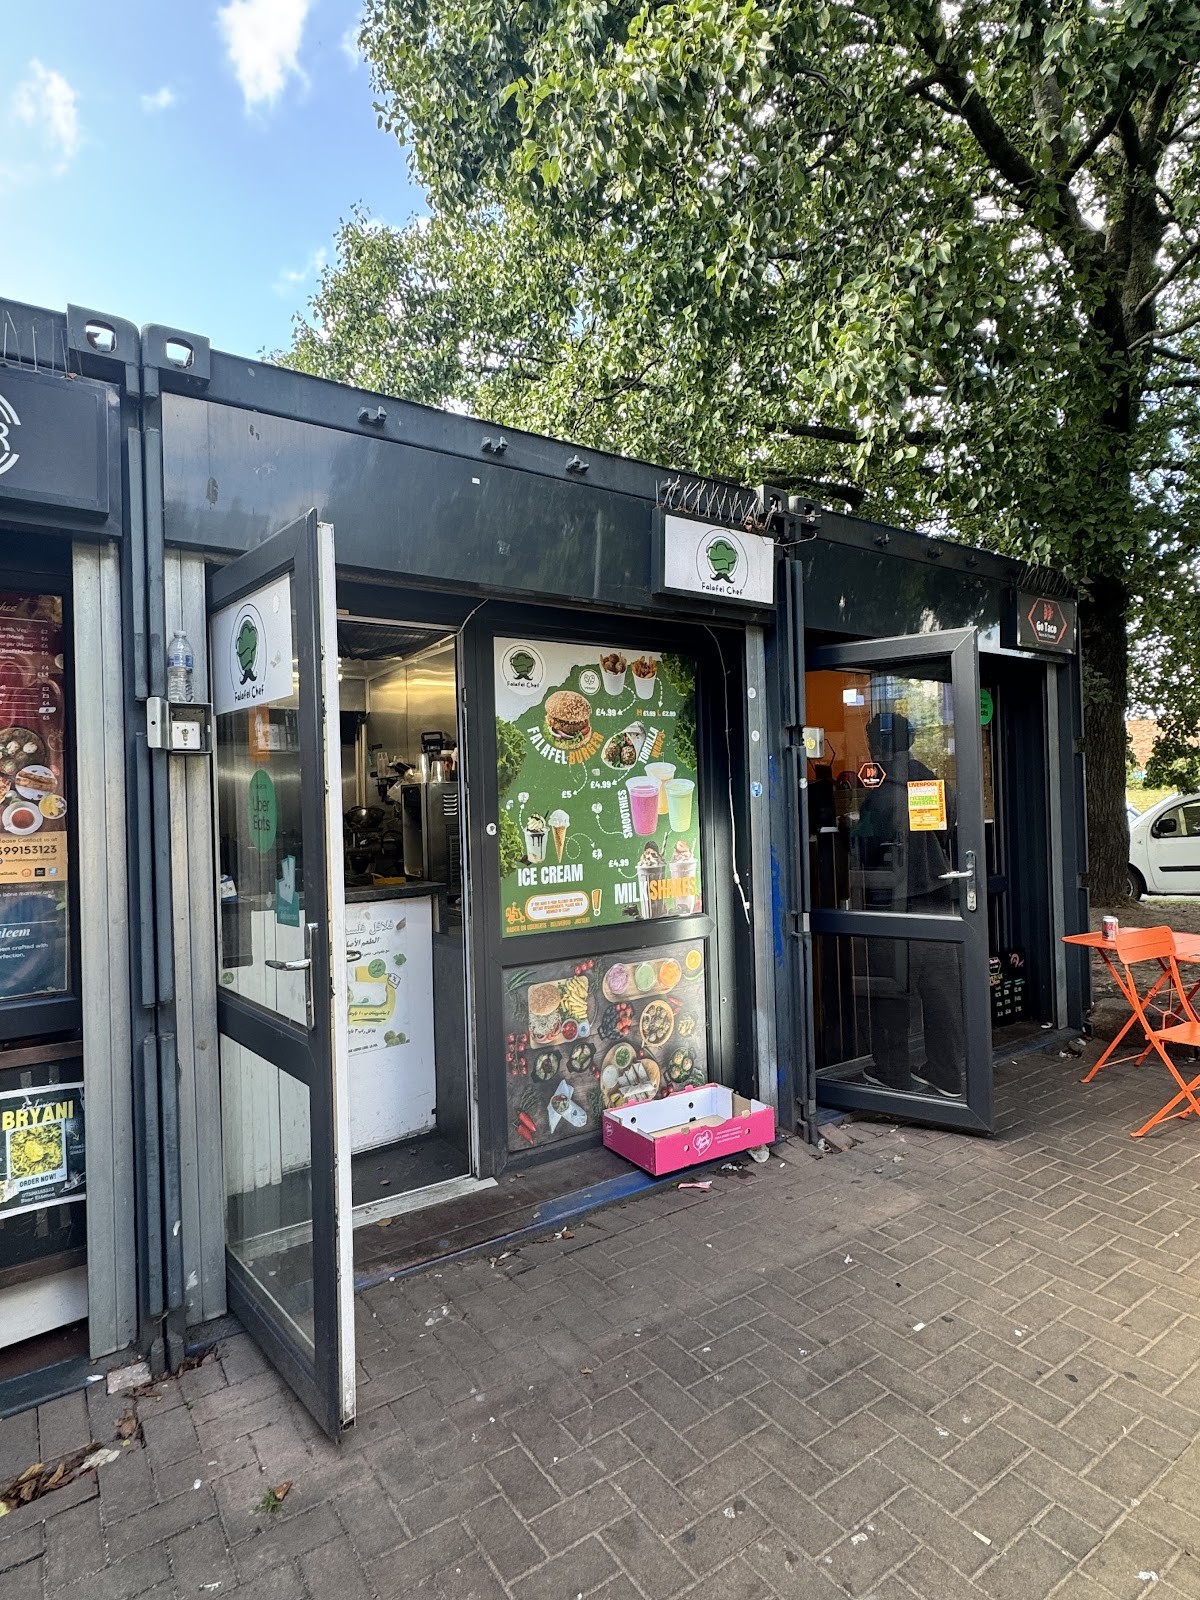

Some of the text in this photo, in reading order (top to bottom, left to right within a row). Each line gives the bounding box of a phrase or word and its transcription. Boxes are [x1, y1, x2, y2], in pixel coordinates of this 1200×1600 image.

[701, 581, 743, 595] Falafel Chef
[1036, 620, 1058, 634] Go Taco
[234, 684, 265, 703] Falafel Chef
[595, 707, 617, 717] £4.99
[527, 725, 604, 765] FALAFEL BURGER
[637, 726, 659, 764] TORTILLA
[590, 780, 612, 789] £4.99
[561, 790, 572, 799] £5
[252, 796, 270, 812] Uber
[617, 789, 633, 839] SMOOTHIES
[253, 815, 271, 831] Eats
[608, 858, 630, 868] £4.99
[517, 863, 584, 887] ICE CREAM
[2, 1100, 74, 1131] BRYANI
[19, 1172, 57, 1188] ORDER NOW!
